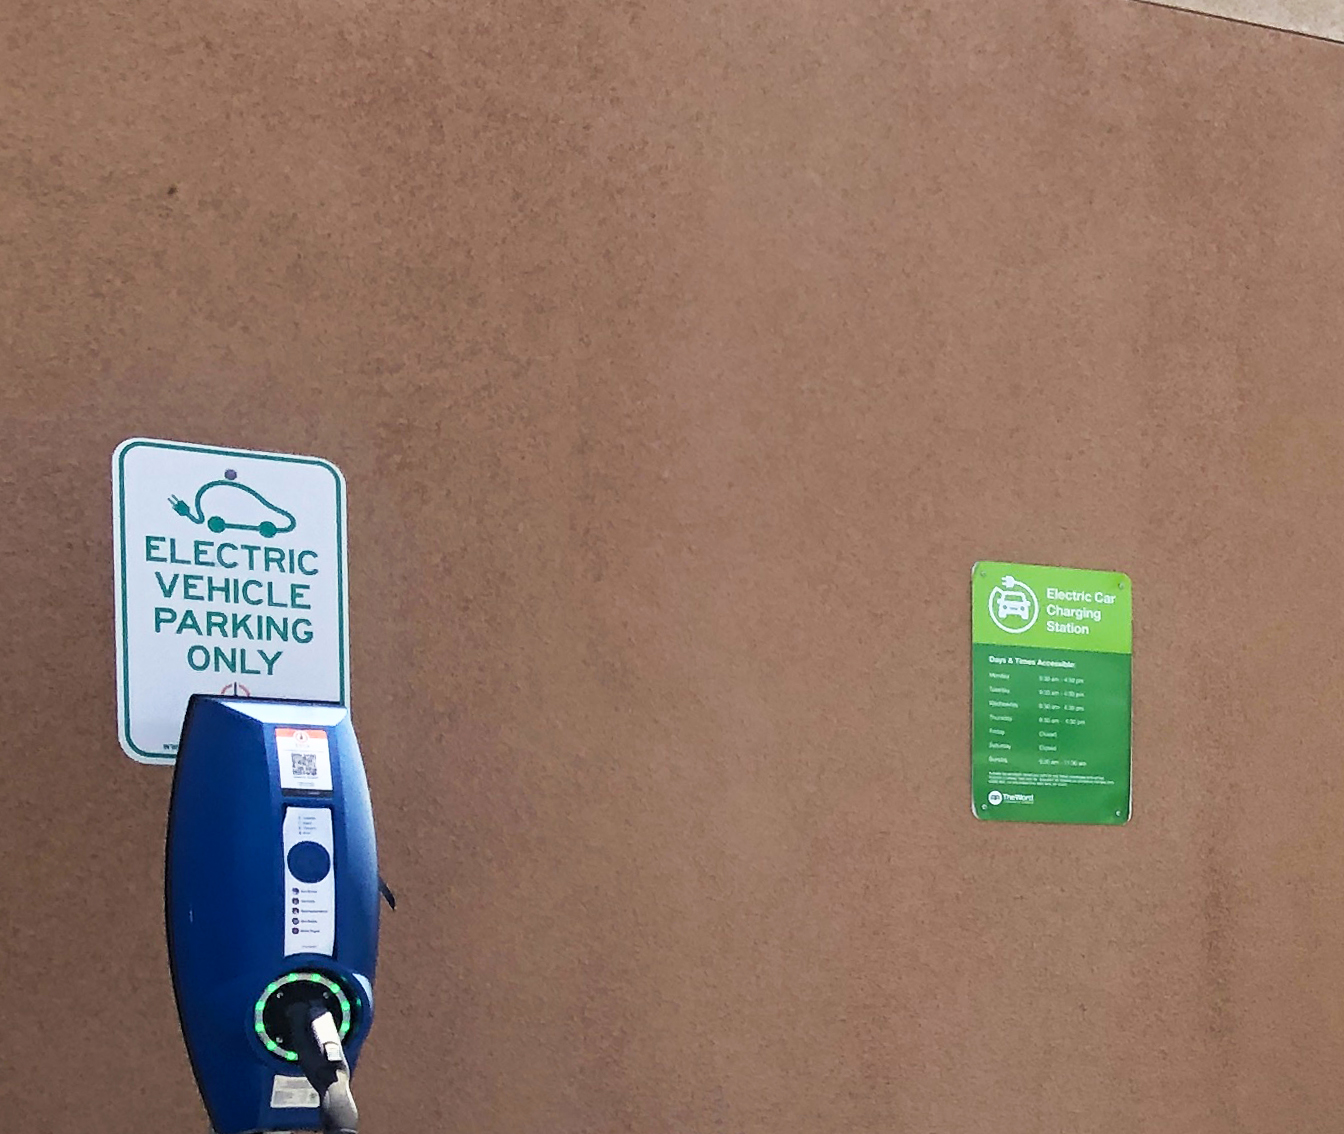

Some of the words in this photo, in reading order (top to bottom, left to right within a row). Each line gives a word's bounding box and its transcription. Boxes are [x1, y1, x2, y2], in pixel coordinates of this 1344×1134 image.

[145, 535, 319, 576] ELECTRIC
[154, 571, 311, 609] VEHICLE
[1046, 588, 1092, 602] Electric
[1094, 592, 1116, 604] Car
[1046, 604, 1101, 622] Charging
[154, 607, 314, 644] PARKING
[1046, 621, 1089, 635] Station
[187, 645, 283, 676] ONLY
[989, 655, 1006, 665] Days
